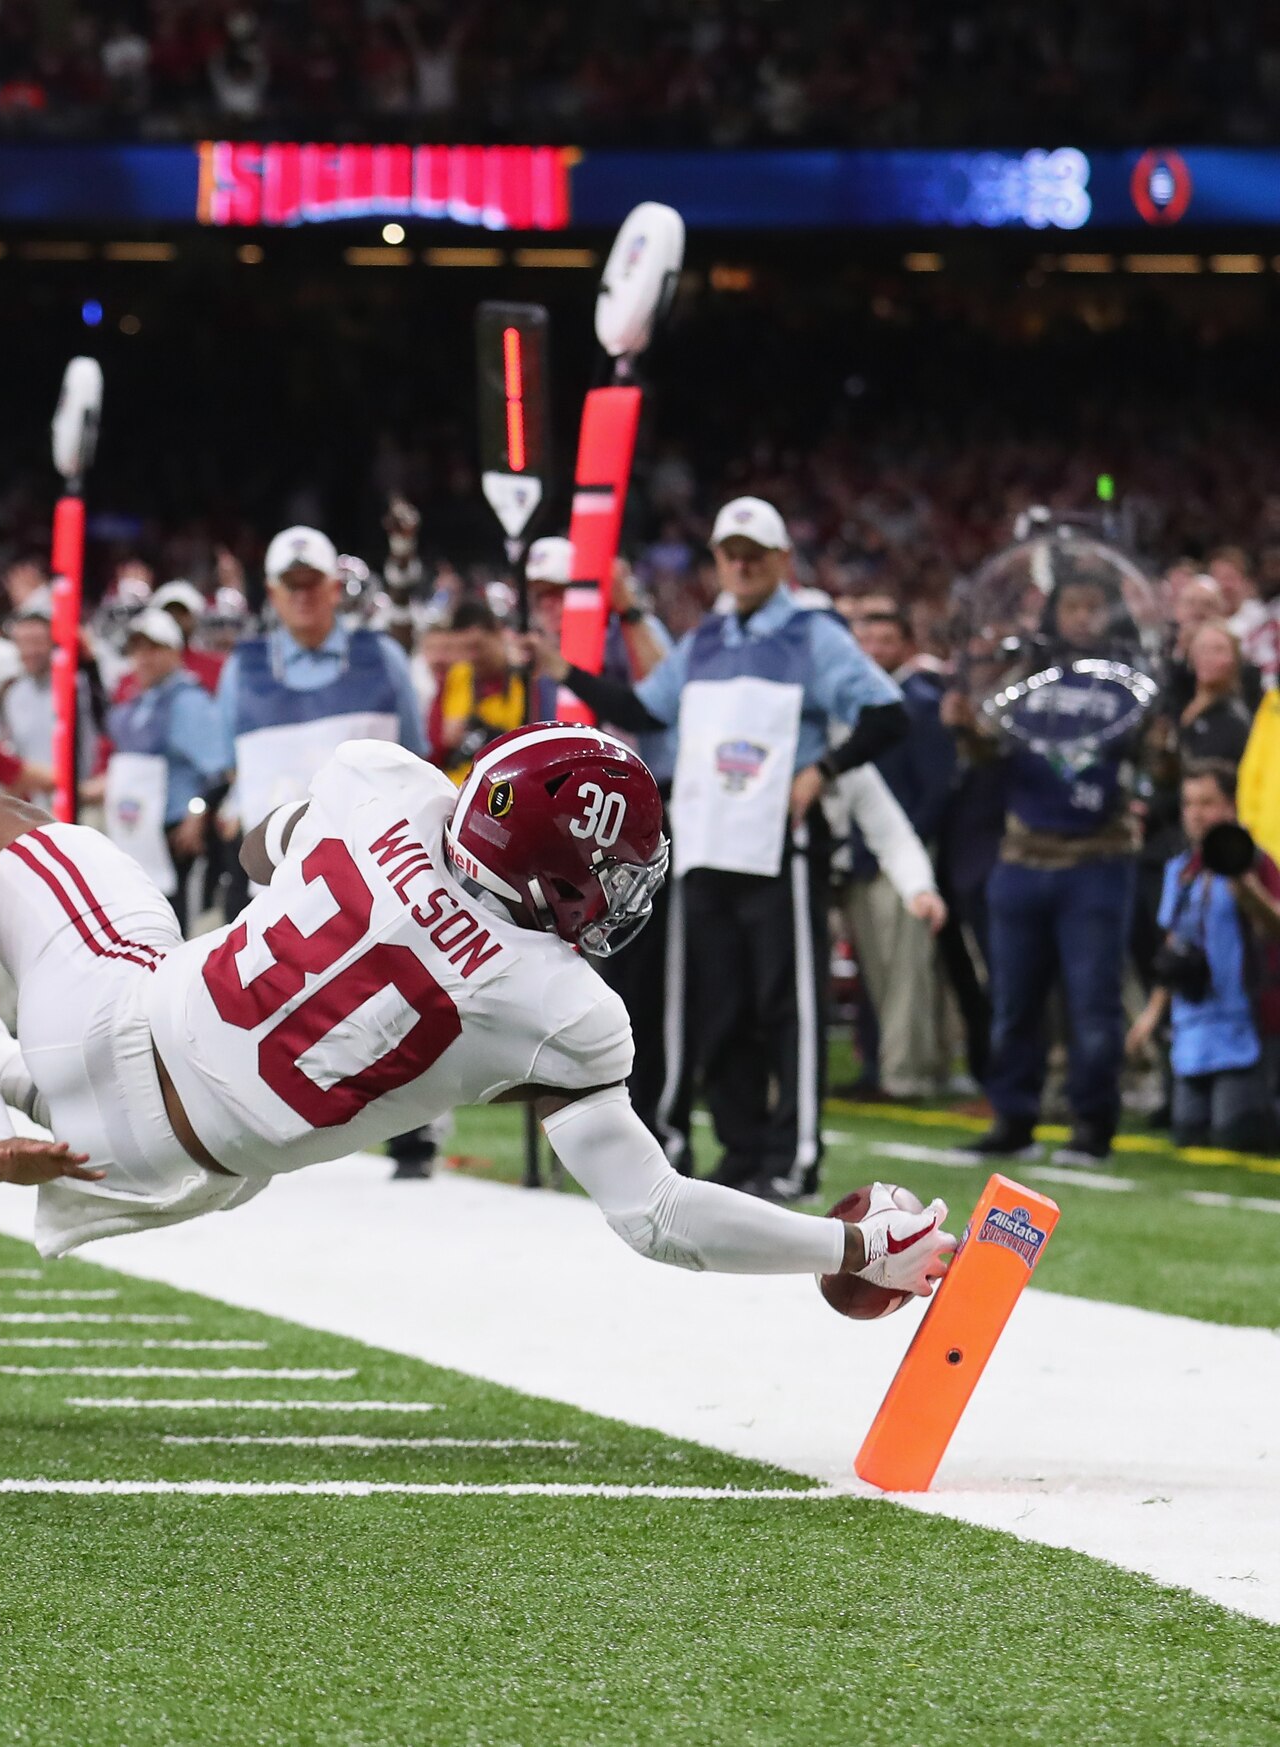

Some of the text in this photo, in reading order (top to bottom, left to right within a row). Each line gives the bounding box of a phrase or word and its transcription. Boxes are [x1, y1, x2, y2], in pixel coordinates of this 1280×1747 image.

[569, 782, 627, 848] 30
[368, 819, 503, 979] WILSON
[202, 838, 463, 1128] 30
[988, 1211, 1039, 1244] Allstate
